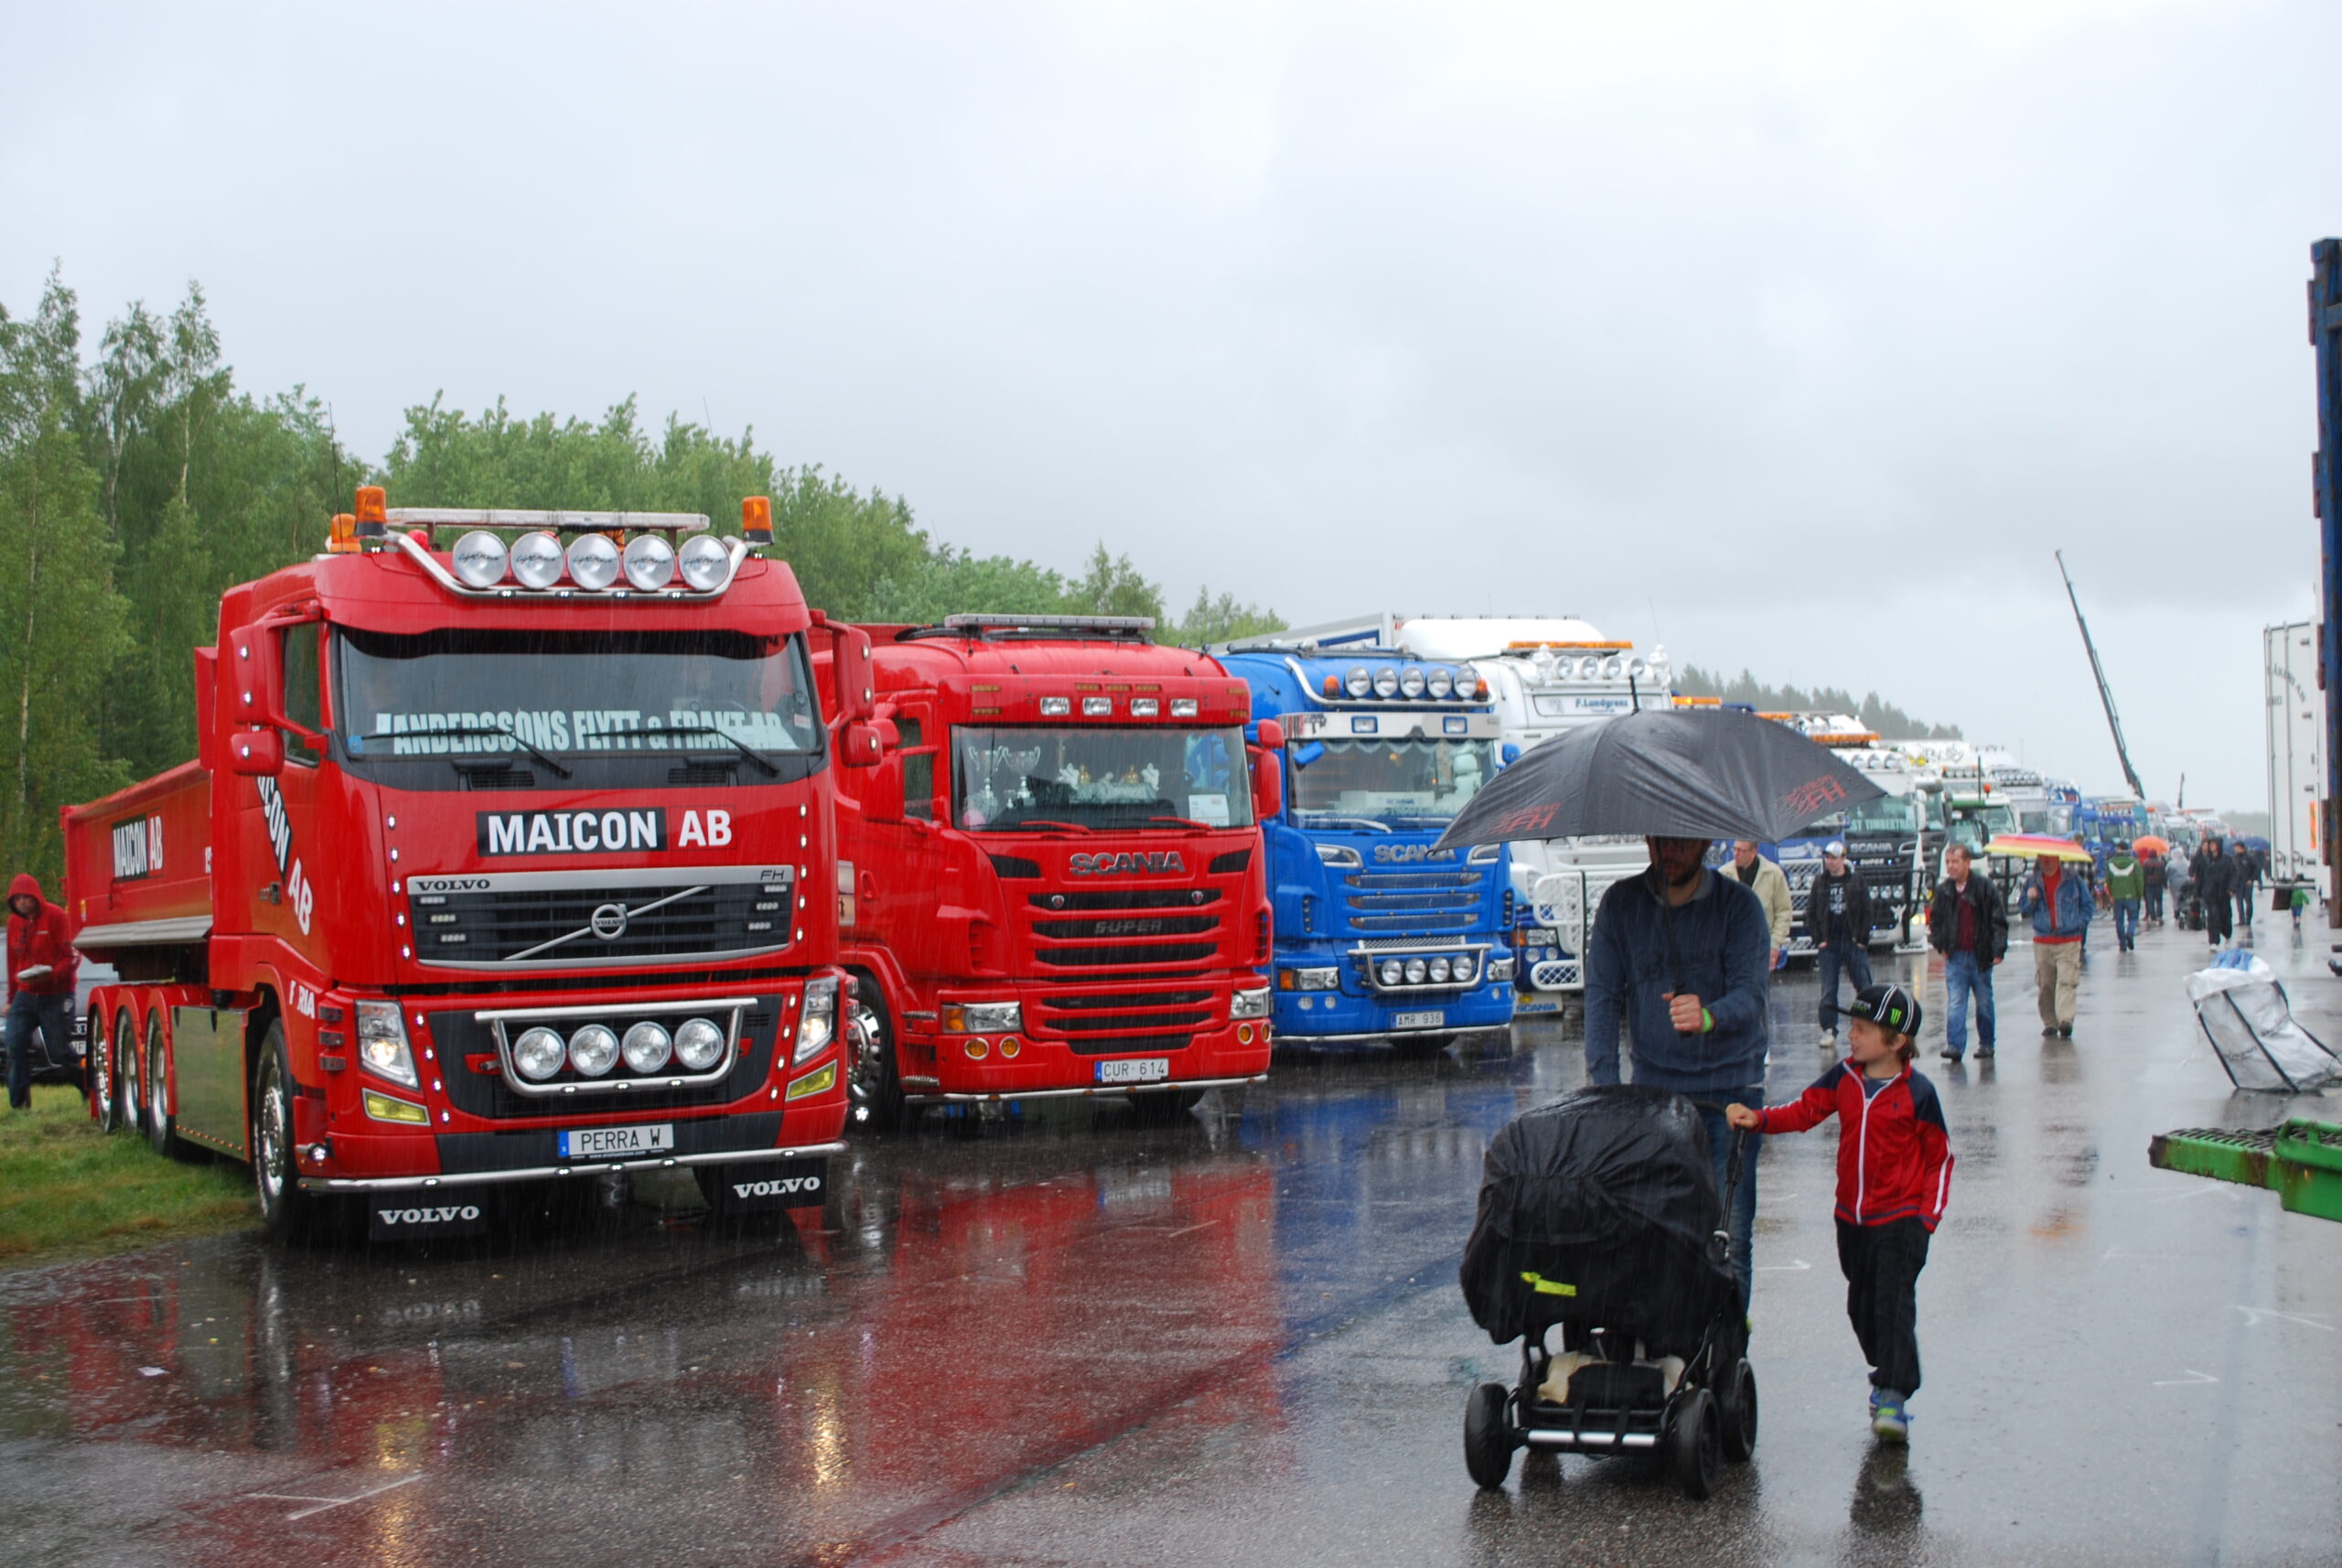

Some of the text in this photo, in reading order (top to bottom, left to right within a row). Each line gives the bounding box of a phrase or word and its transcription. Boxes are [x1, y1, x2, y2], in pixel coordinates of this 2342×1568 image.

[393, 711, 570, 755] ANDERSSONS
[573, 710, 640, 749] FLYTT
[648, 715, 668, 749] &
[488, 810, 733, 854] MAICON AB
[113, 820, 147, 876] MAICON
[149, 815, 163, 870] AB
[1850, 843, 1893, 854] SCANIA
[1069, 851, 1187, 876] SCANIA
[759, 869, 785, 880] FH
[416, 878, 491, 892] VOLVO
[288, 857, 313, 936] AB
[595, 918, 625, 926] VOLVO
[1094, 920, 1162, 934] SUPER
[1516, 1003, 1558, 1013] SCANIA
[1398, 1012, 1442, 1026] AMR 936
[1104, 1062, 1165, 1077] CUR 614
[580, 1127, 661, 1152] PERRA W
[733, 1176, 821, 1199] VOLVO
[379, 1205, 480, 1225] VOLVO
